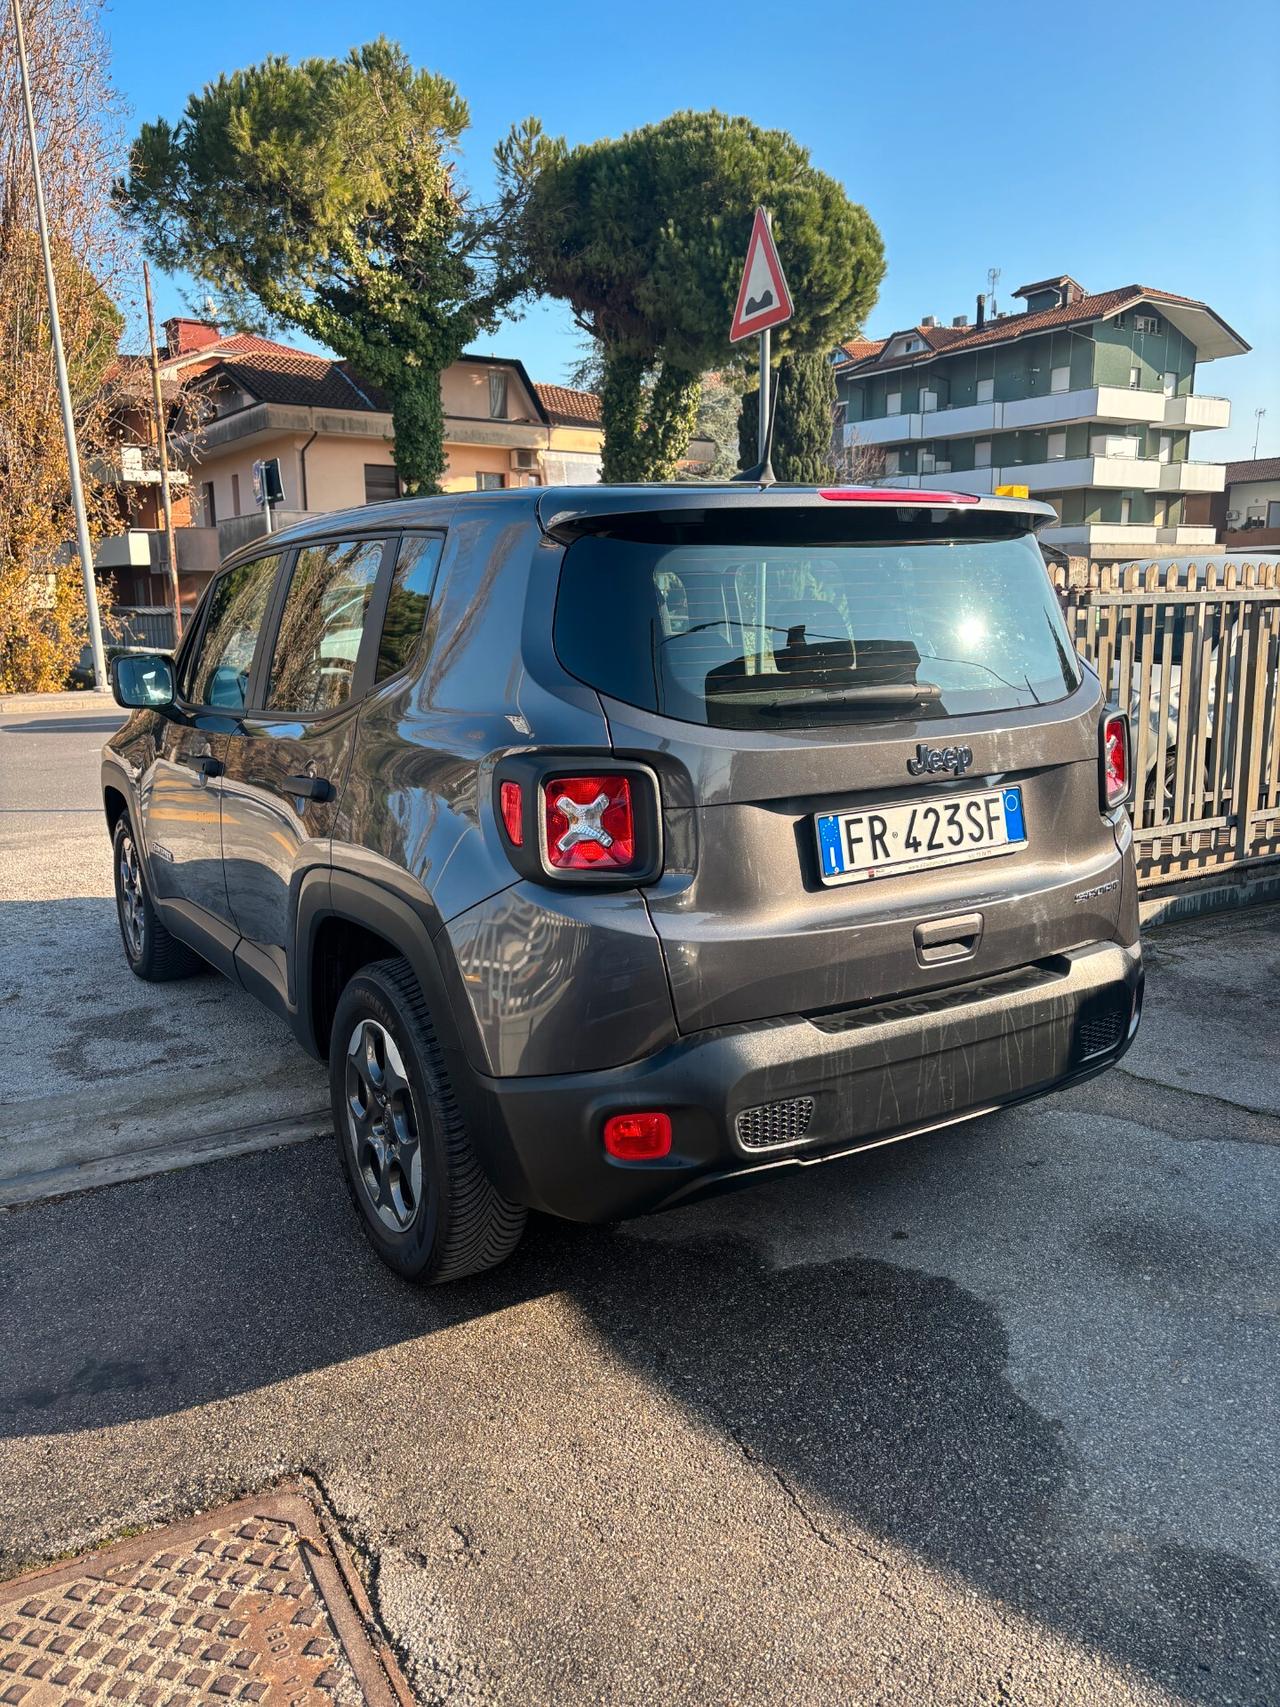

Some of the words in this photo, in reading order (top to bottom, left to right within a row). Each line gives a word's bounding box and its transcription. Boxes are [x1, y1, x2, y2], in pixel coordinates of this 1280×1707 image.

[907, 744, 973, 776] Jeep
[844, 815, 891, 864] FR
[904, 797, 1001, 853] 423SF
